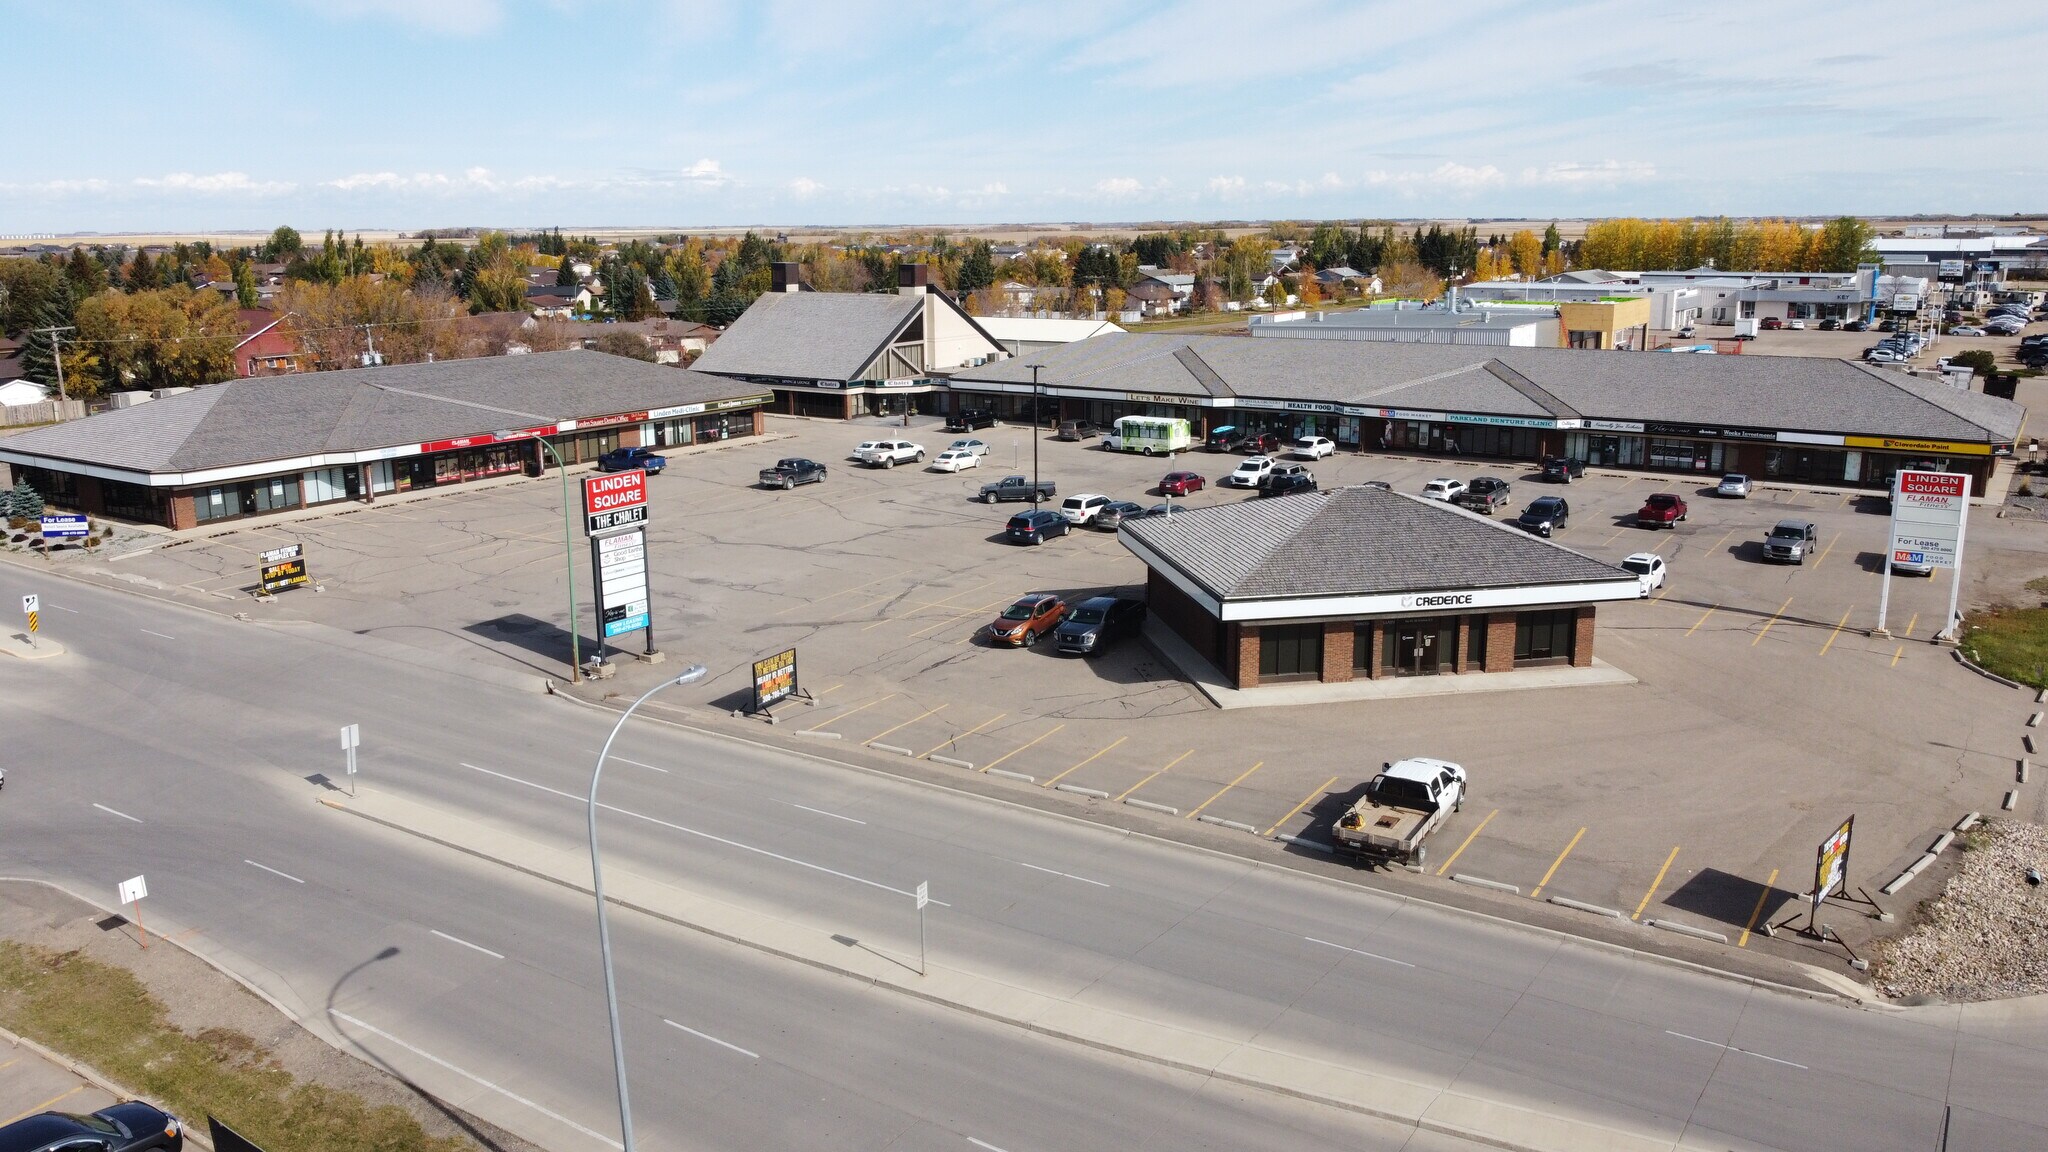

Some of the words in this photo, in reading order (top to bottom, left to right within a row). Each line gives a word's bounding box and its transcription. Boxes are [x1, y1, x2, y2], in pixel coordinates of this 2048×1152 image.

[653, 408, 671, 418] Linden
[592, 474, 640, 493] LINDEN
[1908, 474, 1958, 484] LINDEN
[1907, 484, 1957, 494] SQUARE
[594, 488, 642, 508] SQUARE
[1906, 494, 1948, 504] FLAMAN
[595, 514, 612, 529] THE
[614, 508, 642, 525] CHALET
[605, 534, 634, 546] FLAMAN
[1914, 539, 1940, 548] Lease
[260, 550, 280, 558] FLAMAN
[280, 545, 298, 554] FITNESS
[268, 552, 290, 562] BOWFLEX
[1896, 552, 1922, 562] M&M
[264, 570, 276, 580] STOP
[286, 566, 300, 574] TODAY
[1416, 594, 1472, 606] CREDENCE
